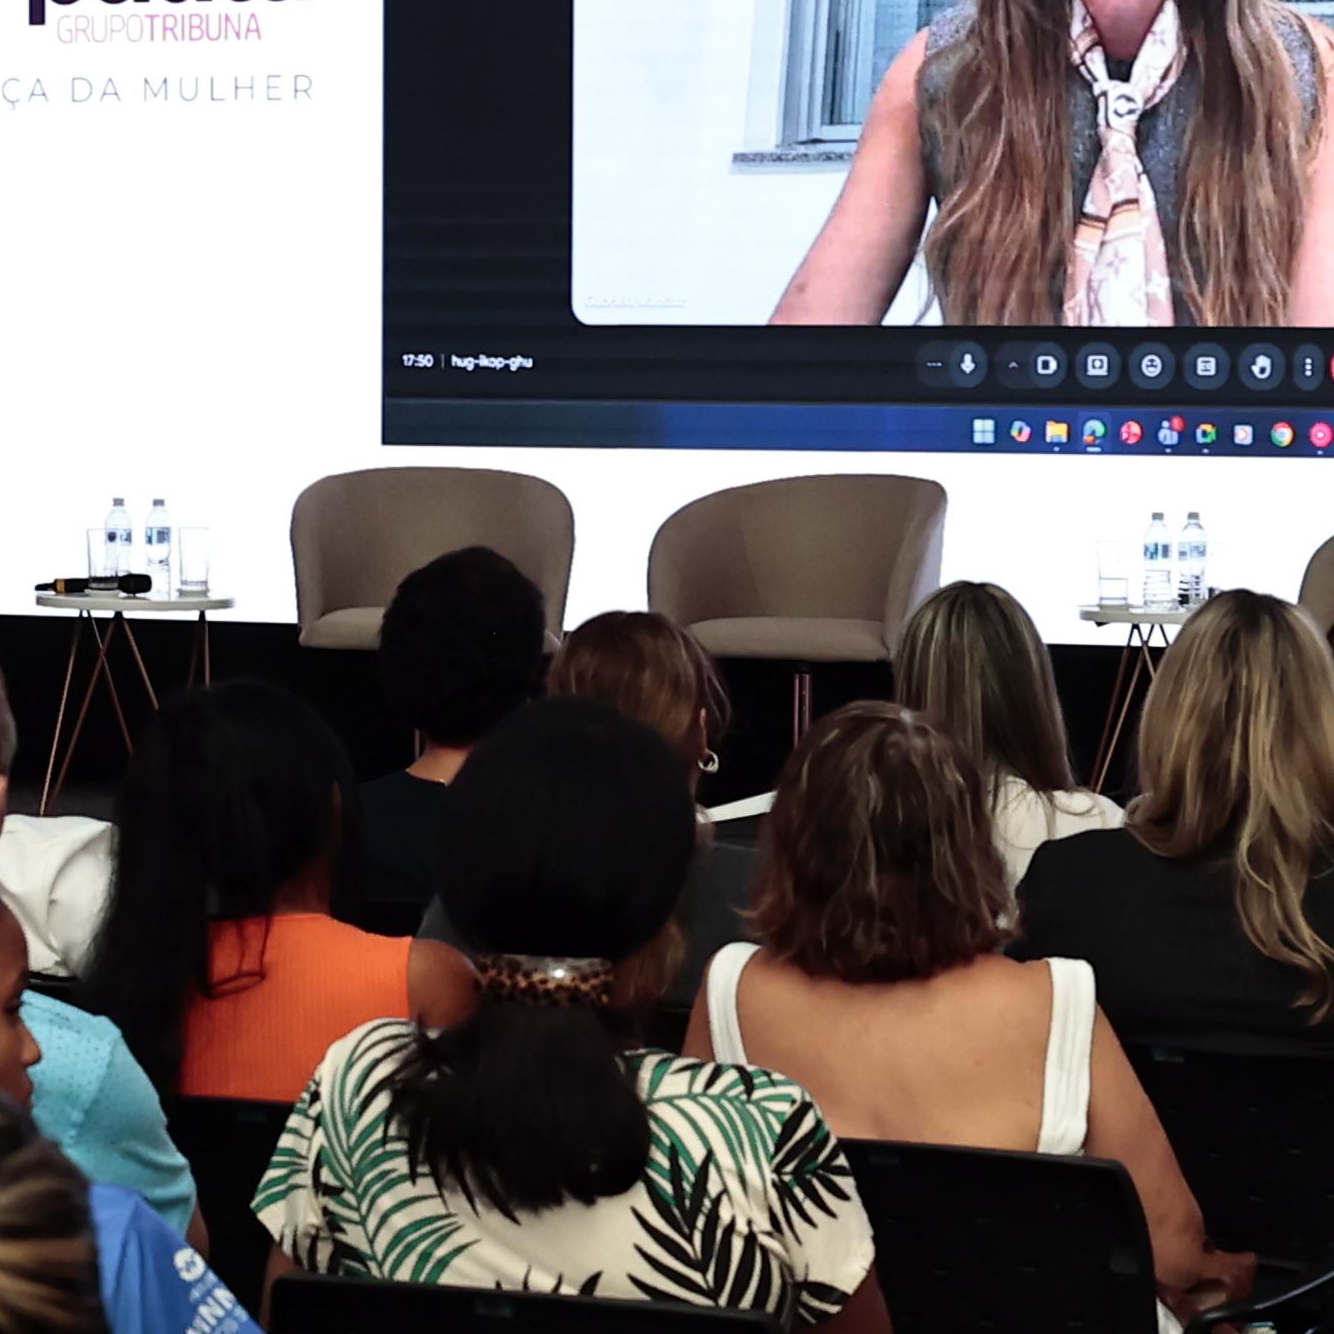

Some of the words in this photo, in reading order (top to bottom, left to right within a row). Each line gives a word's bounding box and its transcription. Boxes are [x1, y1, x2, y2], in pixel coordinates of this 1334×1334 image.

[71, 75, 122, 104] DA
[143, 73, 313, 103] MULHER
[402, 354, 434, 369] 17:50
